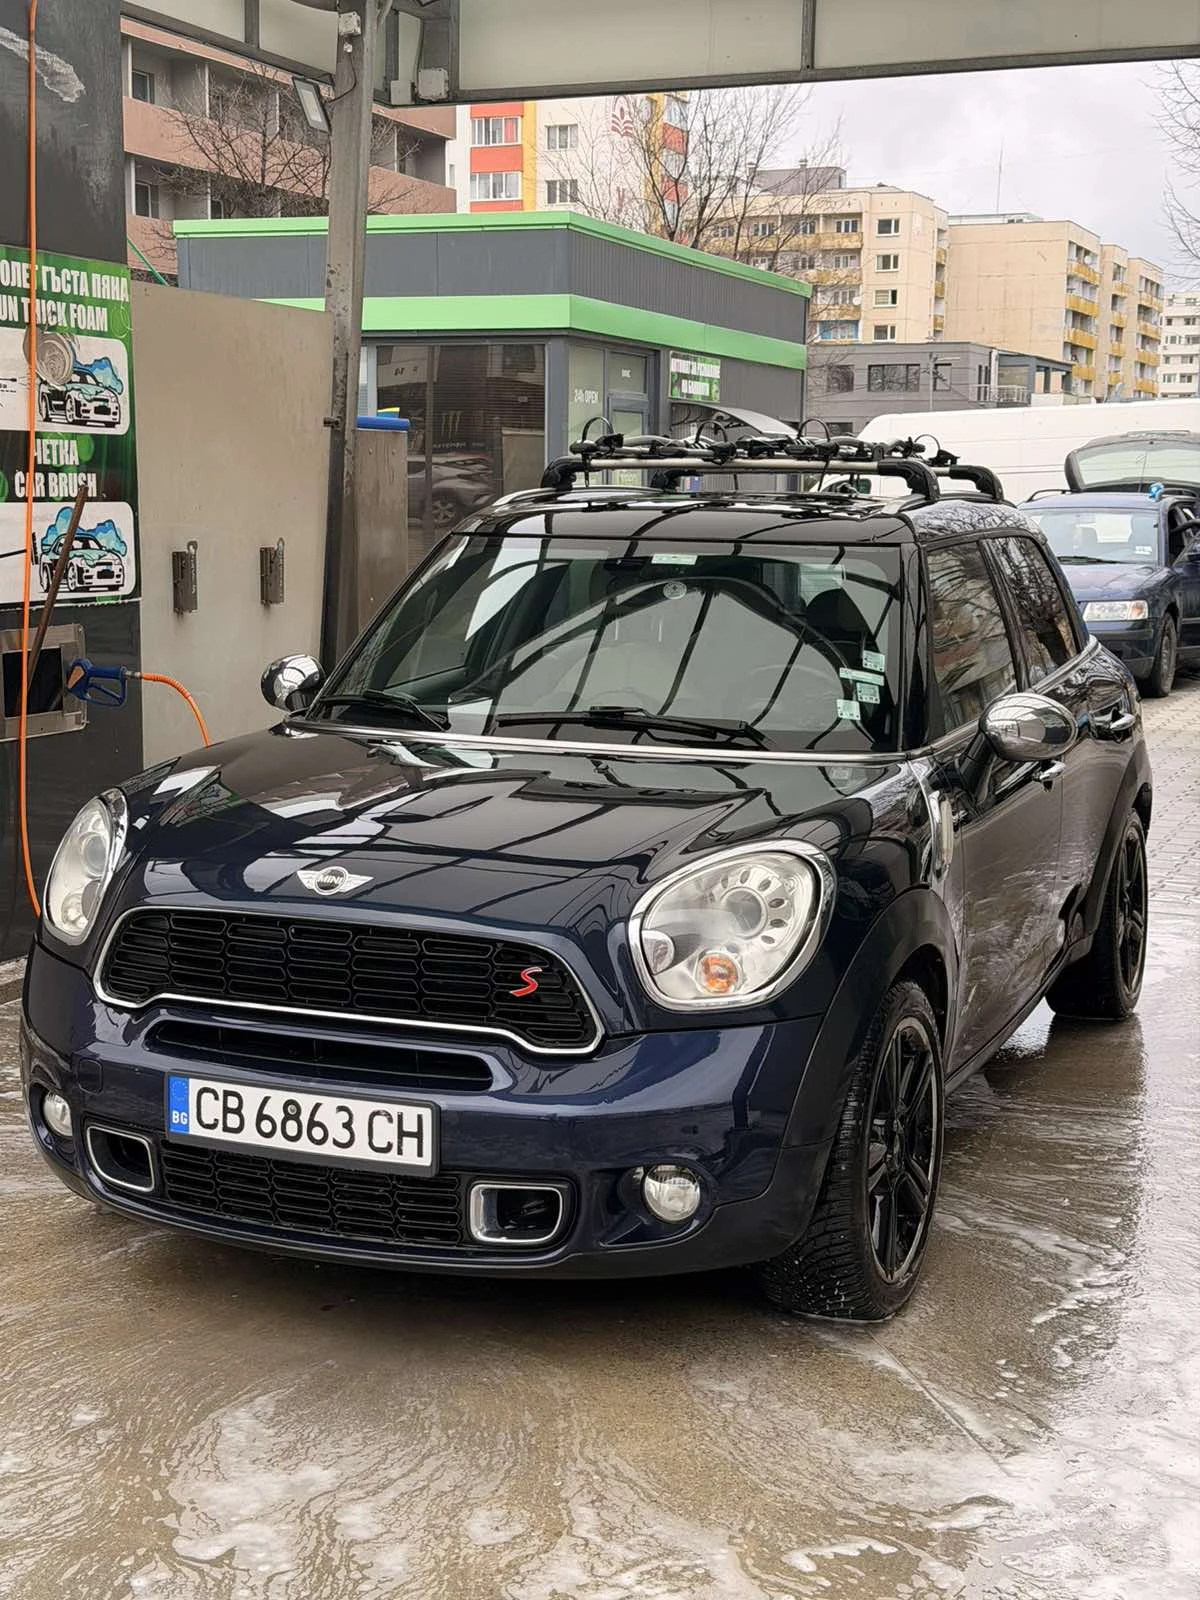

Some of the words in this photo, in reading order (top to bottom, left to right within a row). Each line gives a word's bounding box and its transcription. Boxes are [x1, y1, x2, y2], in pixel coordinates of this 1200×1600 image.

[41, 265, 89, 297] ГЪСТА
[91, 272, 129, 302] ПЯНА
[69, 303, 108, 332] FOAM
[14, 470, 46, 498] CAR
[48, 472, 98, 498] BRUSH
[318, 874, 344, 885] MINI
[509, 966, 543, 997] S
[172, 1111, 188, 1125] BG
[195, 1086, 245, 1134] CB
[255, 1095, 356, 1149] 6863
[367, 1109, 424, 1158] CH
